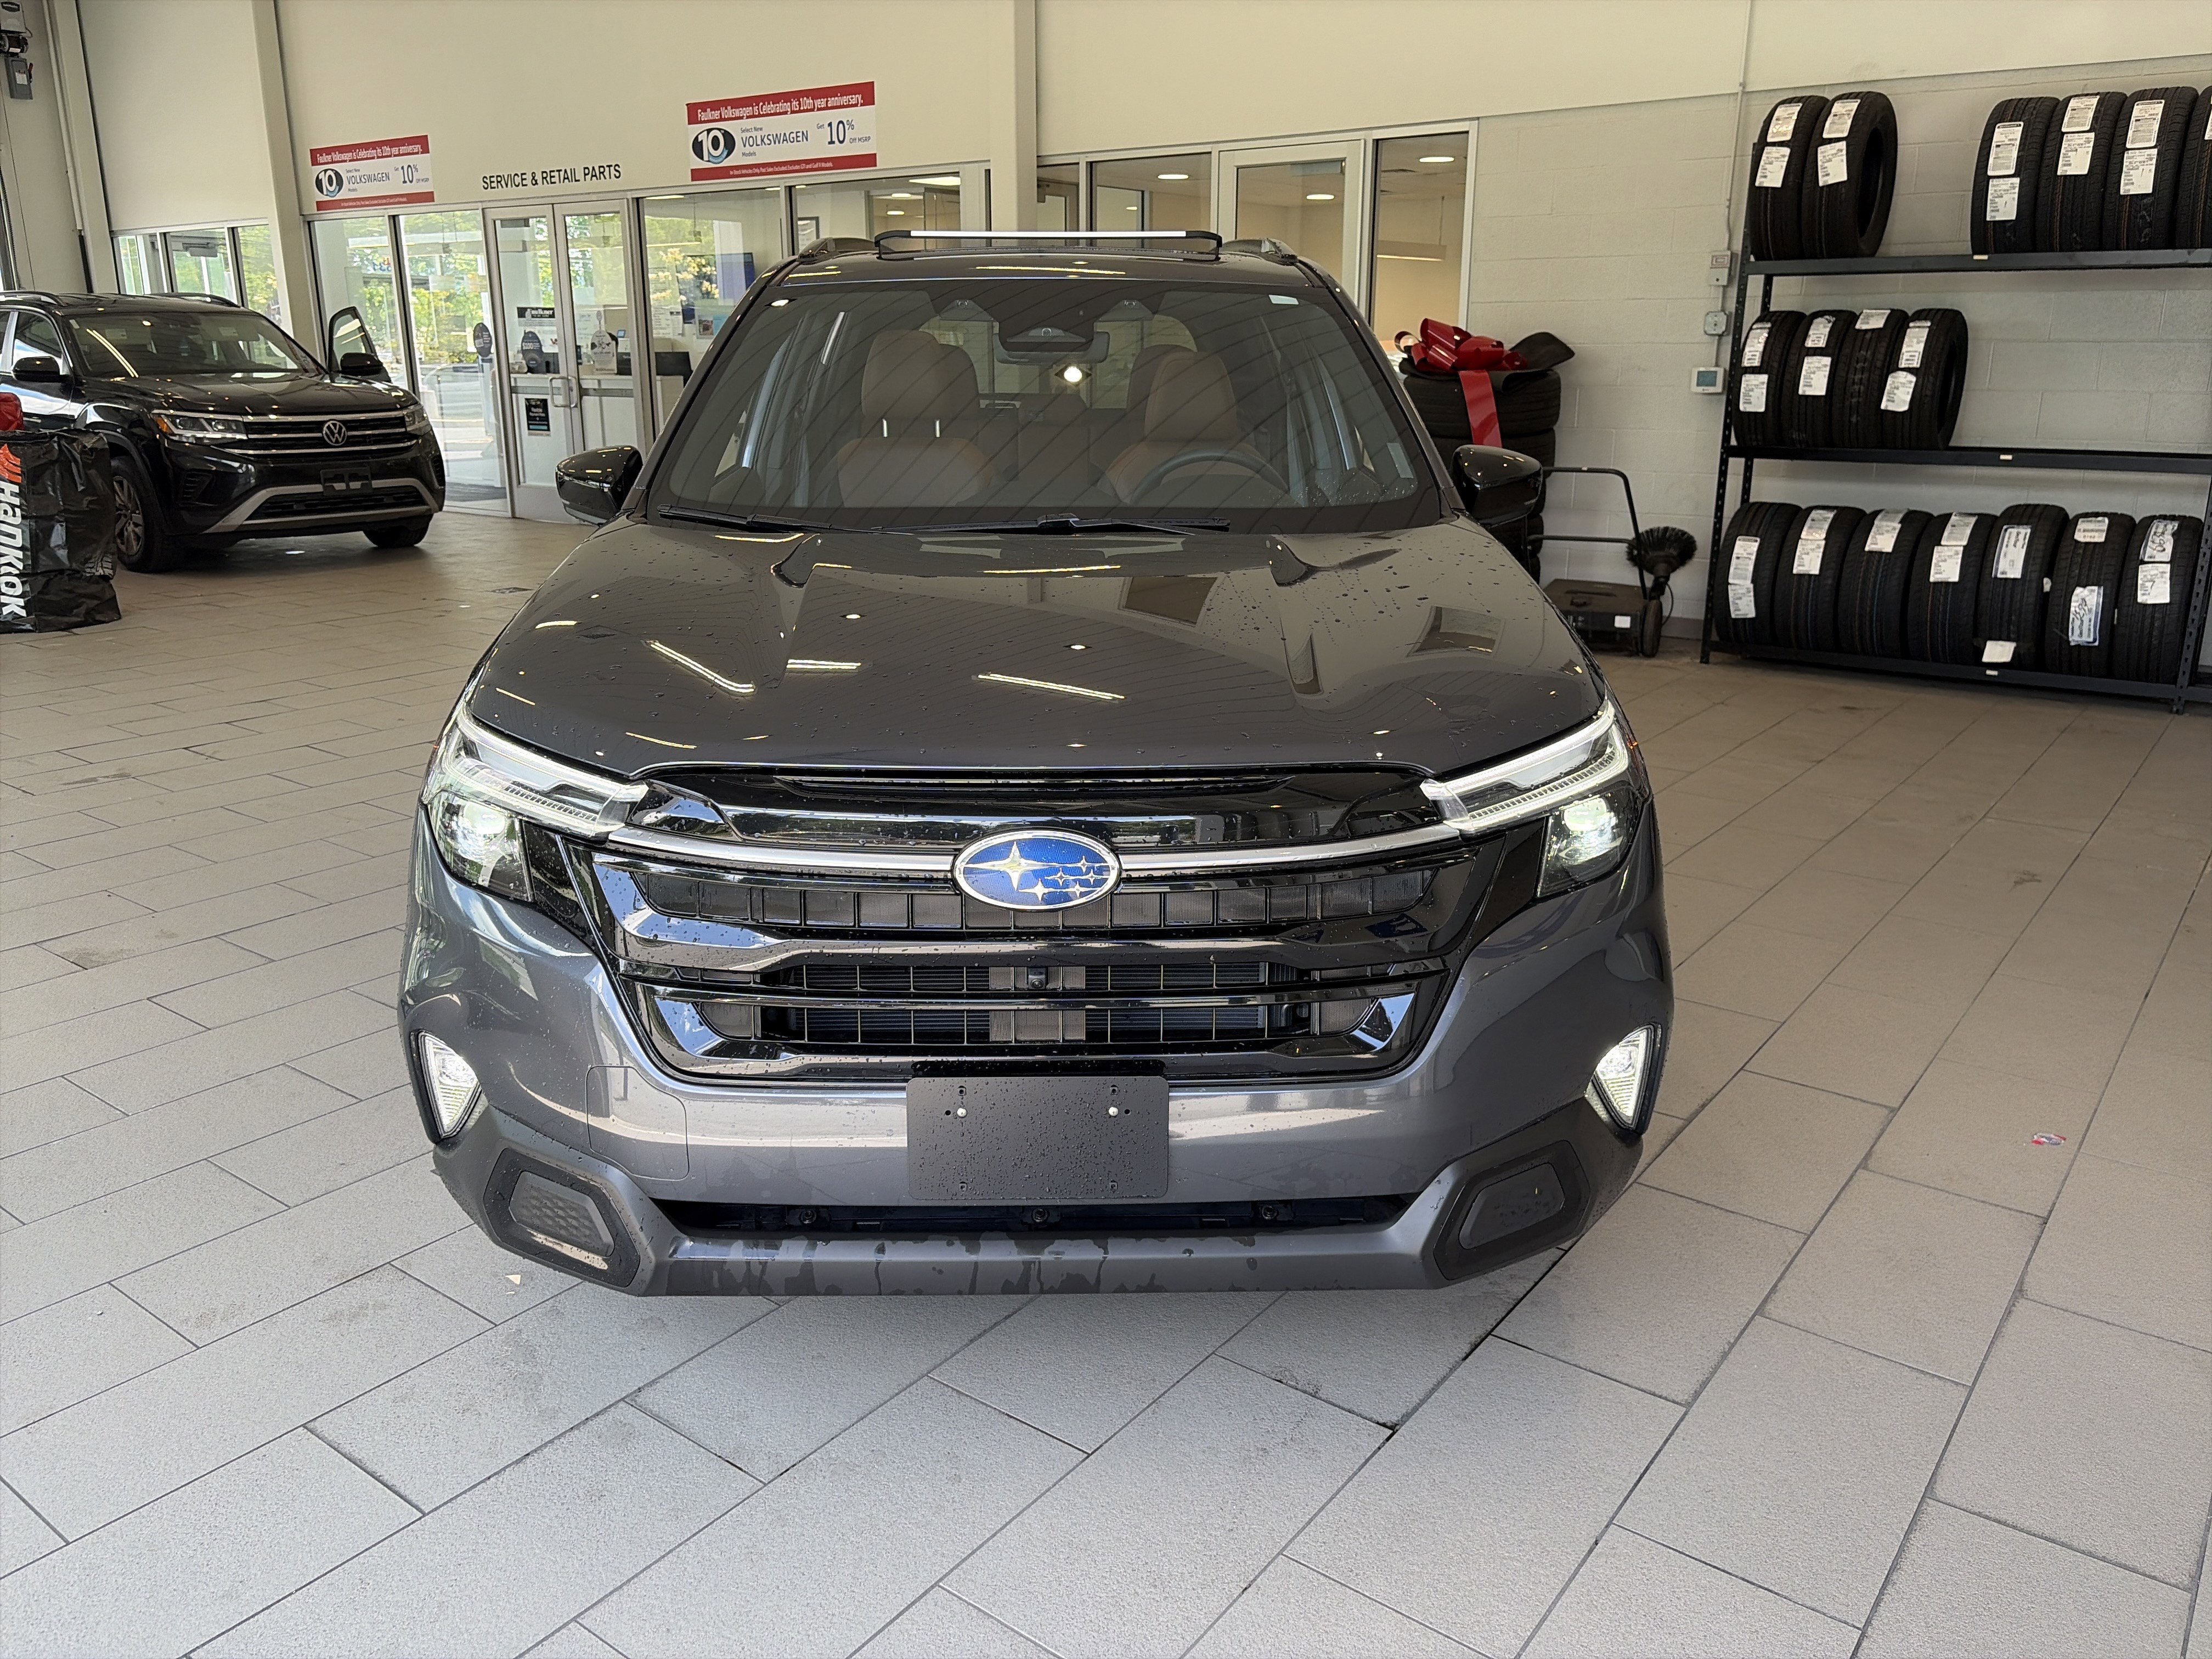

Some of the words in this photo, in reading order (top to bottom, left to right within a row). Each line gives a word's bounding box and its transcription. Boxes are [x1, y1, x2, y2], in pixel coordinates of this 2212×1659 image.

[697, 108, 720, 121] Faulkner
[720, 106, 753, 119] Volkswagen
[753, 103, 758, 115] is
[759, 99, 791, 115] Celebrating
[800, 97, 814, 110] 10th
[814, 97, 827, 111] year
[827, 93, 864, 107] anniversary.
[698, 129, 725, 161] 10
[741, 130, 809, 148] VOLKSWAGEN
[319, 170, 336, 195] 10
[346, 172, 390, 185] VOLKSWAGEN
[482, 172, 528, 190] SERVICE
[531, 171, 539, 186] &
[541, 167, 580, 185] RETAIL
[583, 163, 622, 182] PARTS
